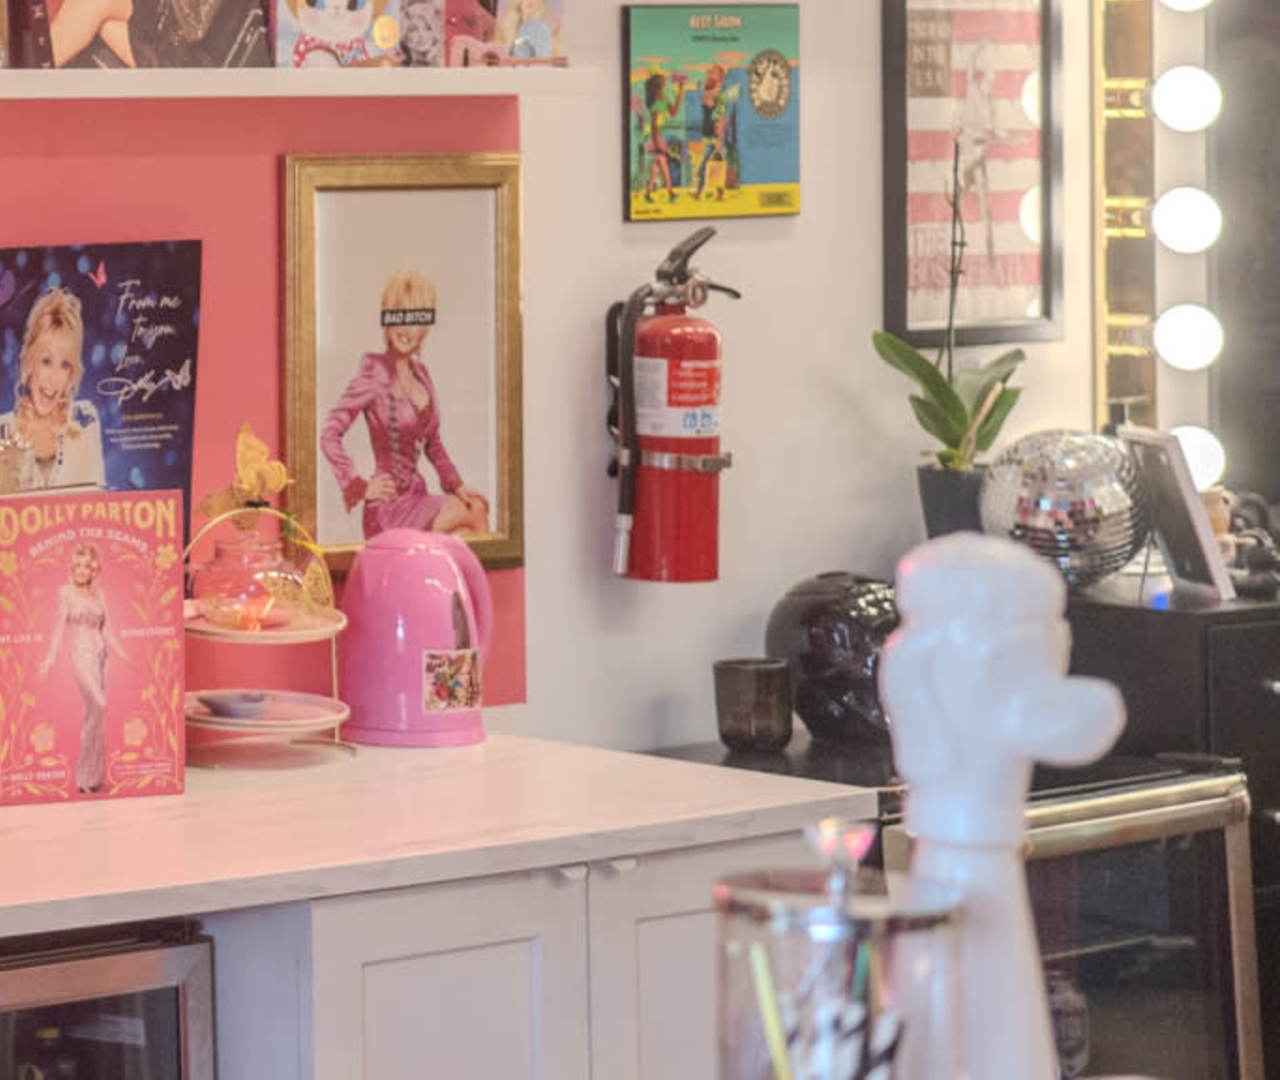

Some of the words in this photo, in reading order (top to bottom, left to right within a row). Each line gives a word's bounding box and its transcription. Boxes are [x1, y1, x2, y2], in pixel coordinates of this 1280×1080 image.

[81, 497, 178, 539] PARTON
[27, 528, 76, 558] BEHIND
[79, 527, 104, 539] THE
[106, 527, 149, 553] SEAMS
